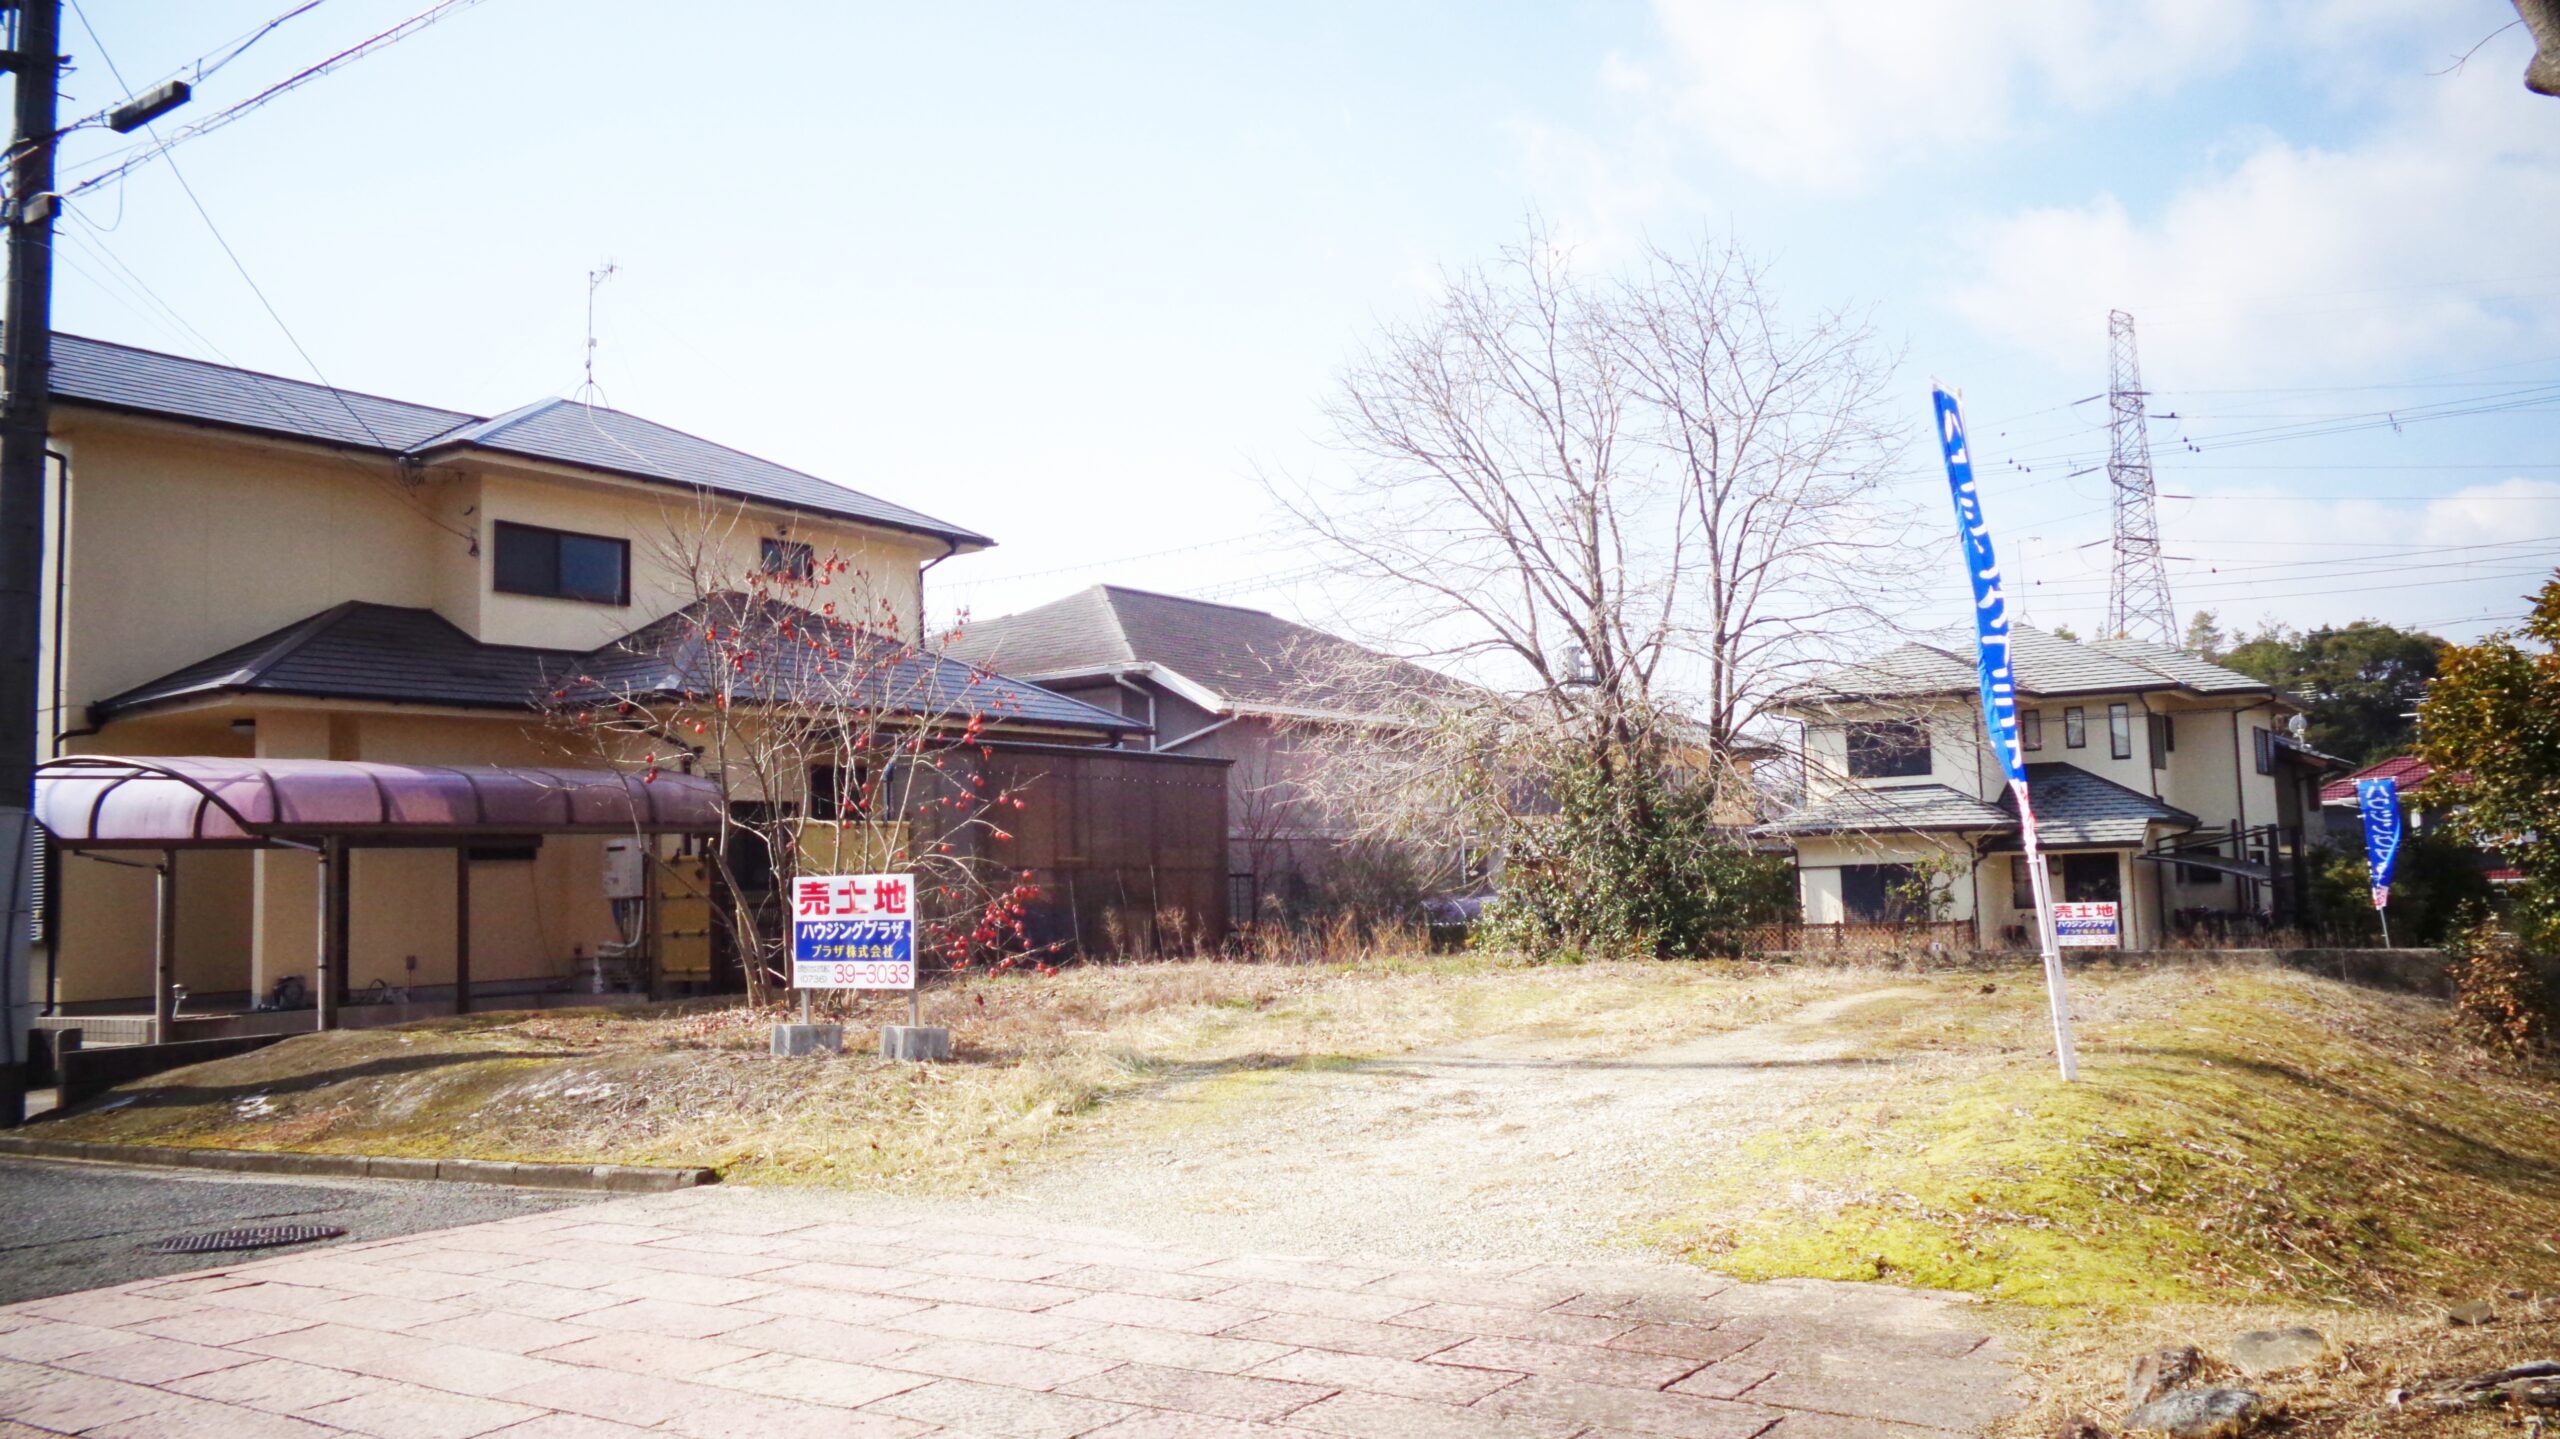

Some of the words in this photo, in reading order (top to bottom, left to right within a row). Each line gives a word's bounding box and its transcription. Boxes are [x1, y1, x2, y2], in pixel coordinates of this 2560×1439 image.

[799, 879, 907, 916] 売土地
[2054, 904, 2114, 919] 売土地
[801, 921, 905, 940] ハウジングプラザ
[812, 945, 894, 959] プラザ株式会社
[834, 963, 910, 984] 39-3033
